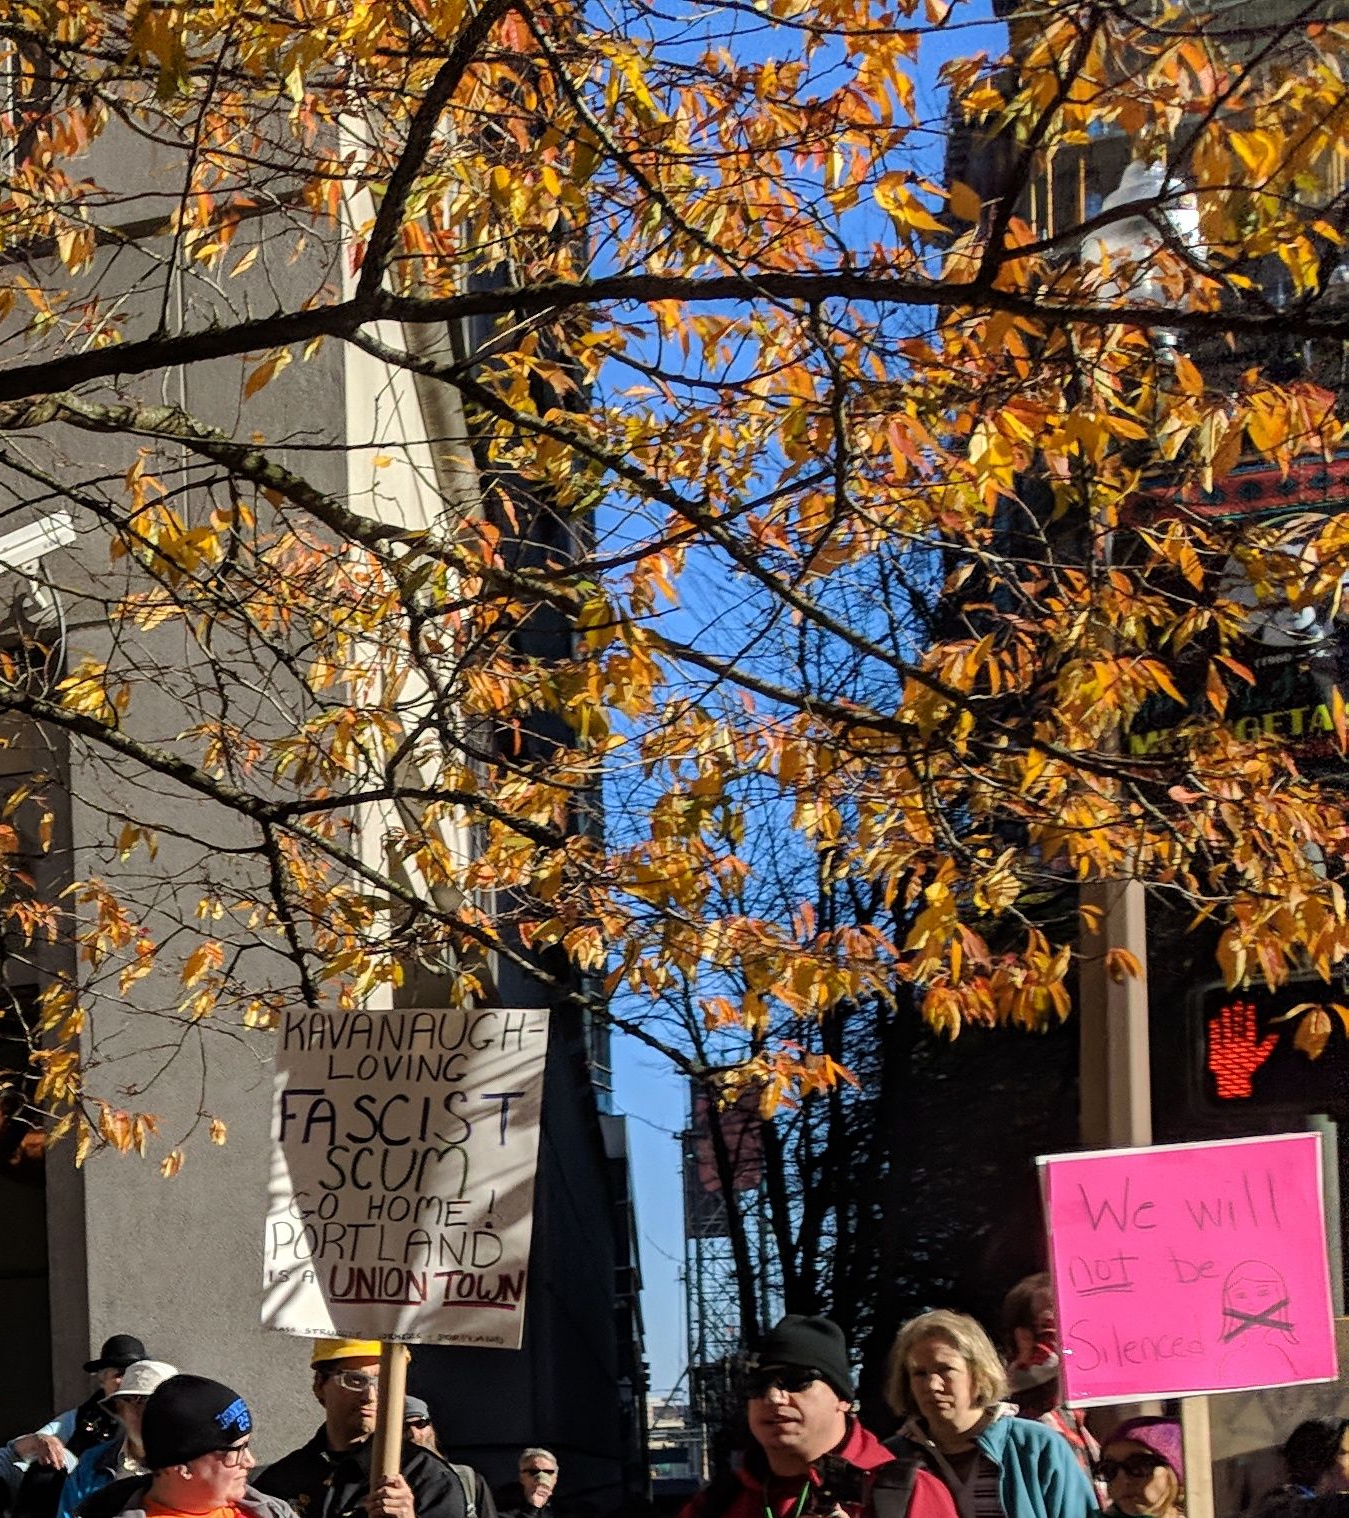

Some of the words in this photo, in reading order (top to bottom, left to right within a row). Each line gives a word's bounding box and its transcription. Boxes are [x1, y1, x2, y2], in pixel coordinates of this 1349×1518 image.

[282, 1010, 545, 1052] KAVANAUGH-
[327, 1053, 468, 1083] LOVING
[278, 1088, 525, 1147] FASCIST
[318, 1144, 471, 1201] SCUM
[288, 1191, 340, 1222] GO
[1077, 1176, 1158, 1232] We
[1185, 1168, 1282, 1233] will
[271, 1221, 504, 1270] PORTLAND
[1068, 1250, 1140, 1285] not
[1166, 1246, 1221, 1285] be
[267, 1270, 291, 1285] IS
[302, 1269, 319, 1285] A
[329, 1266, 428, 1302] UNION
[434, 1270, 527, 1303] TOWN
